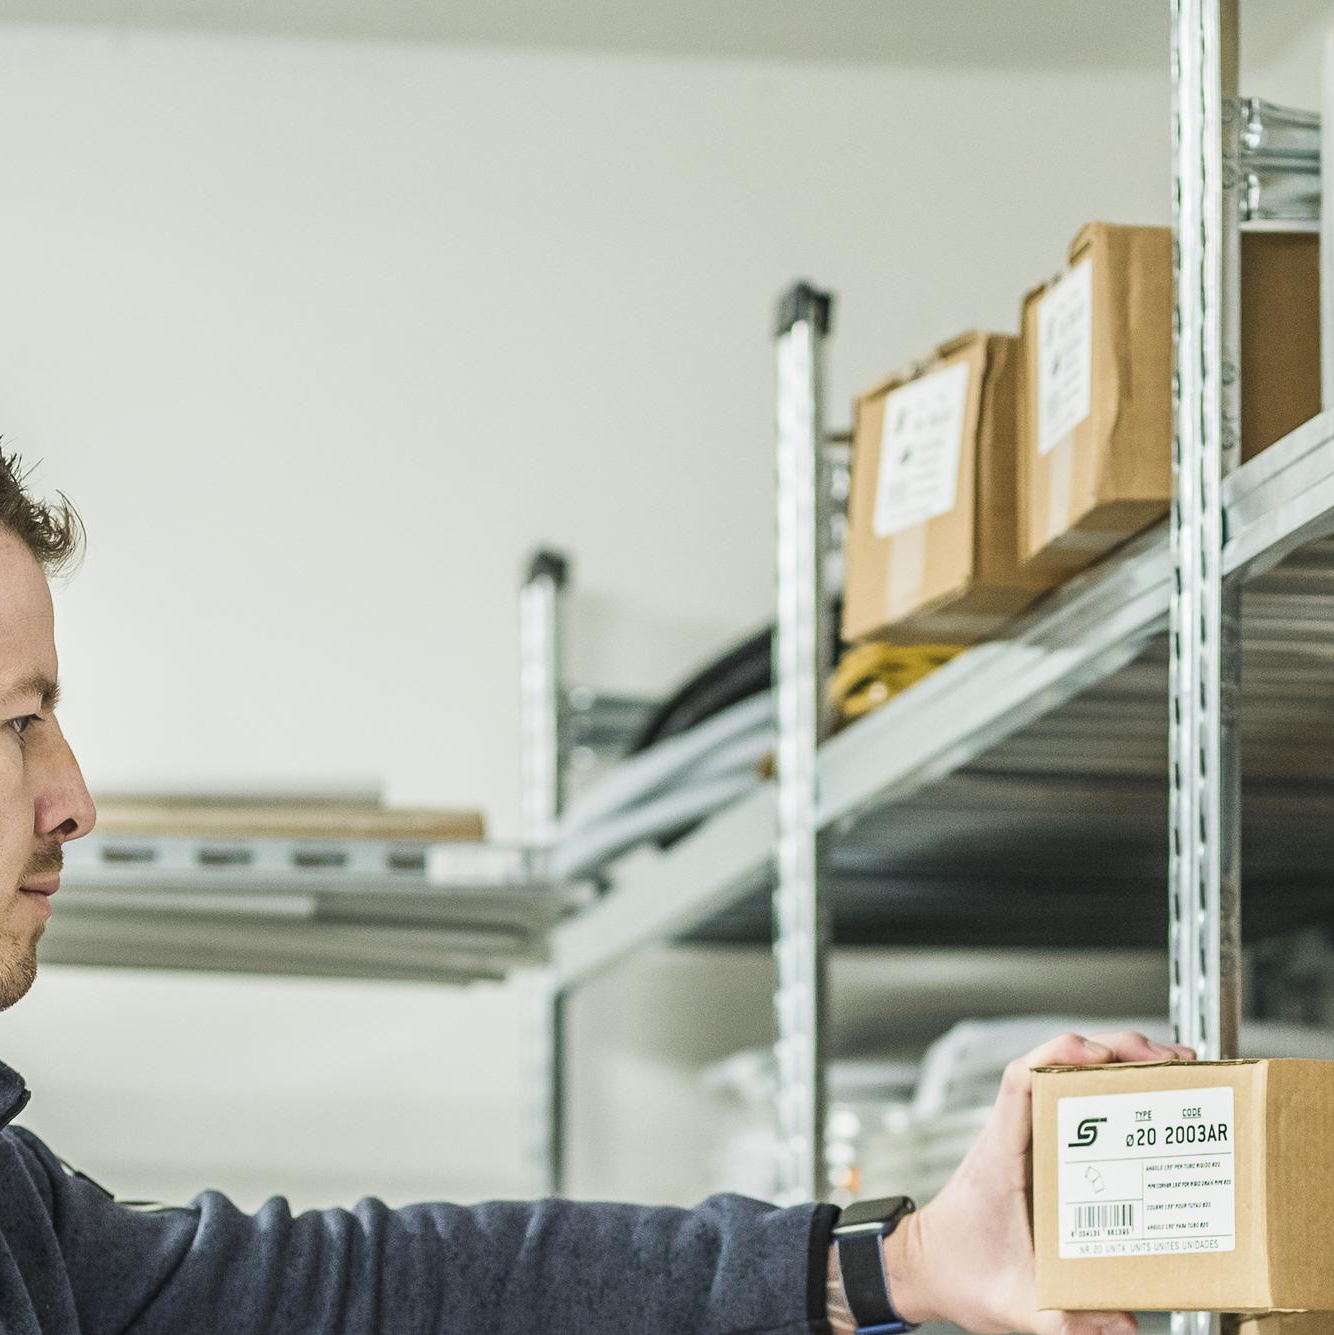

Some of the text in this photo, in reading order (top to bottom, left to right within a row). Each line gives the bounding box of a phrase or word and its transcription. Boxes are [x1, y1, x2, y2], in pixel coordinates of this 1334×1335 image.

[1135, 1107, 1202, 1121] TYPE CODE
[1165, 1123, 1228, 1144] 2003AR
